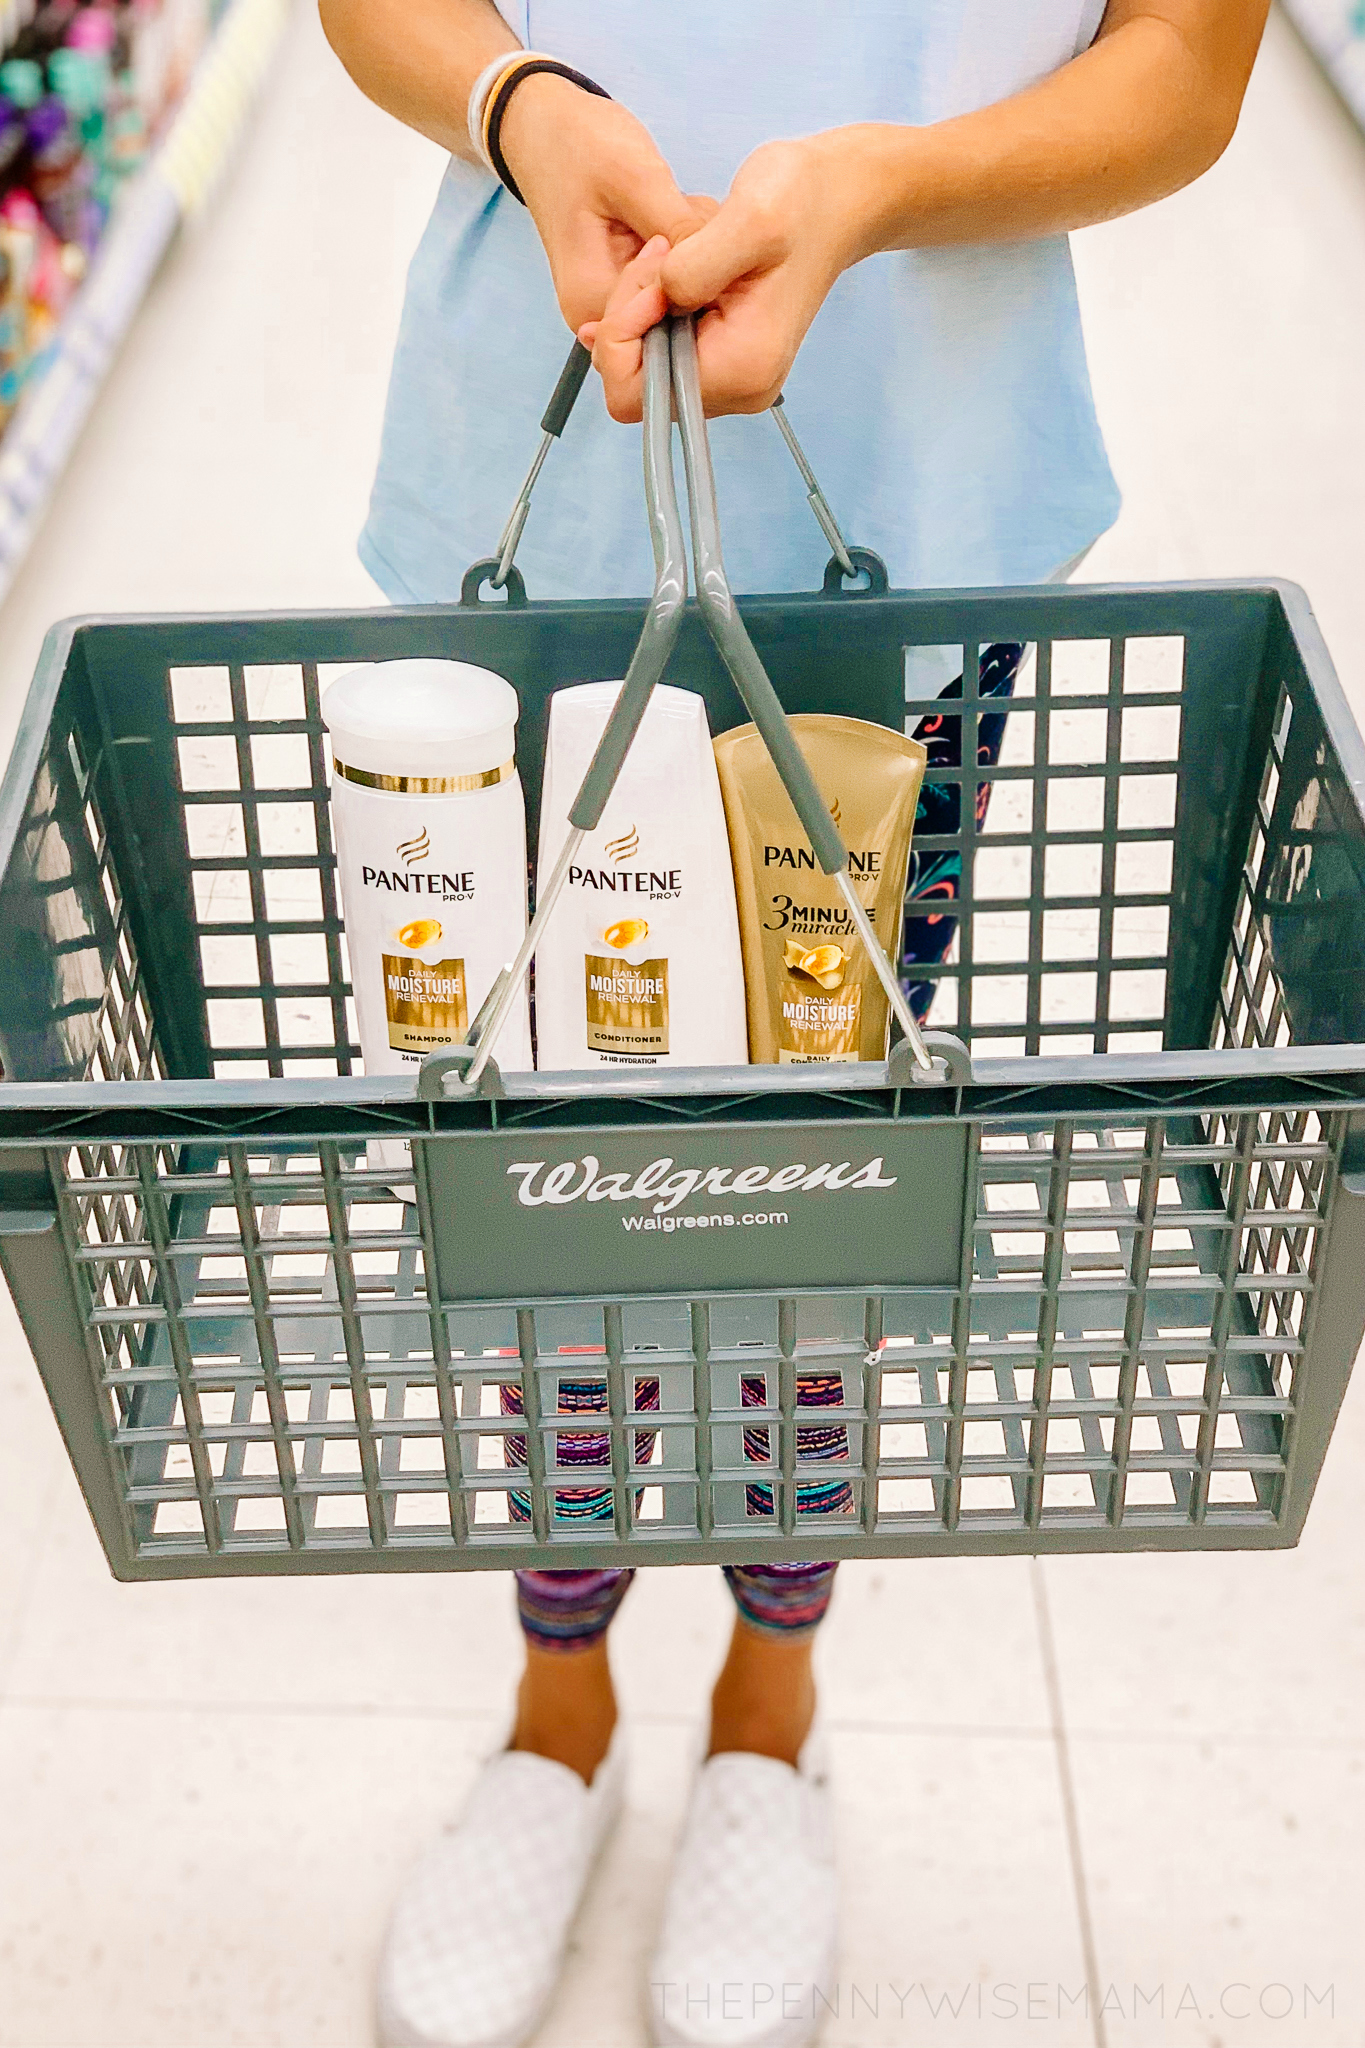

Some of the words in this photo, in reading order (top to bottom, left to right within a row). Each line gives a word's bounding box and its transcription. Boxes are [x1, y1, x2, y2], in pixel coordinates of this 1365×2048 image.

[764, 846, 881, 872] PANNE
[362, 866, 475, 894] PANTENE
[569, 865, 682, 892] PANTENE
[763, 895, 793, 931] 3
[793, 907, 876, 923] MINUE
[408, 970, 437, 979] DAILY
[612, 970, 641, 979] DAILY
[388, 975, 461, 994] MOISTURE
[590, 974, 664, 994] MOISTURE
[396, 992, 455, 1004] RENEWAL
[598, 992, 657, 1004] RENEWAL
[805, 996, 834, 1006] DAILY
[782, 1002, 856, 1021] MOISTURE
[790, 1019, 848, 1031] RENEWAL
[404, 1034, 452, 1043] SHAMPOO
[594, 1032, 662, 1043] CONDITIONER
[401, 1054, 410, 1062] 24
[506, 1155, 897, 1215] Walgreens
[621, 1208, 789, 1233] Walgreens.com
